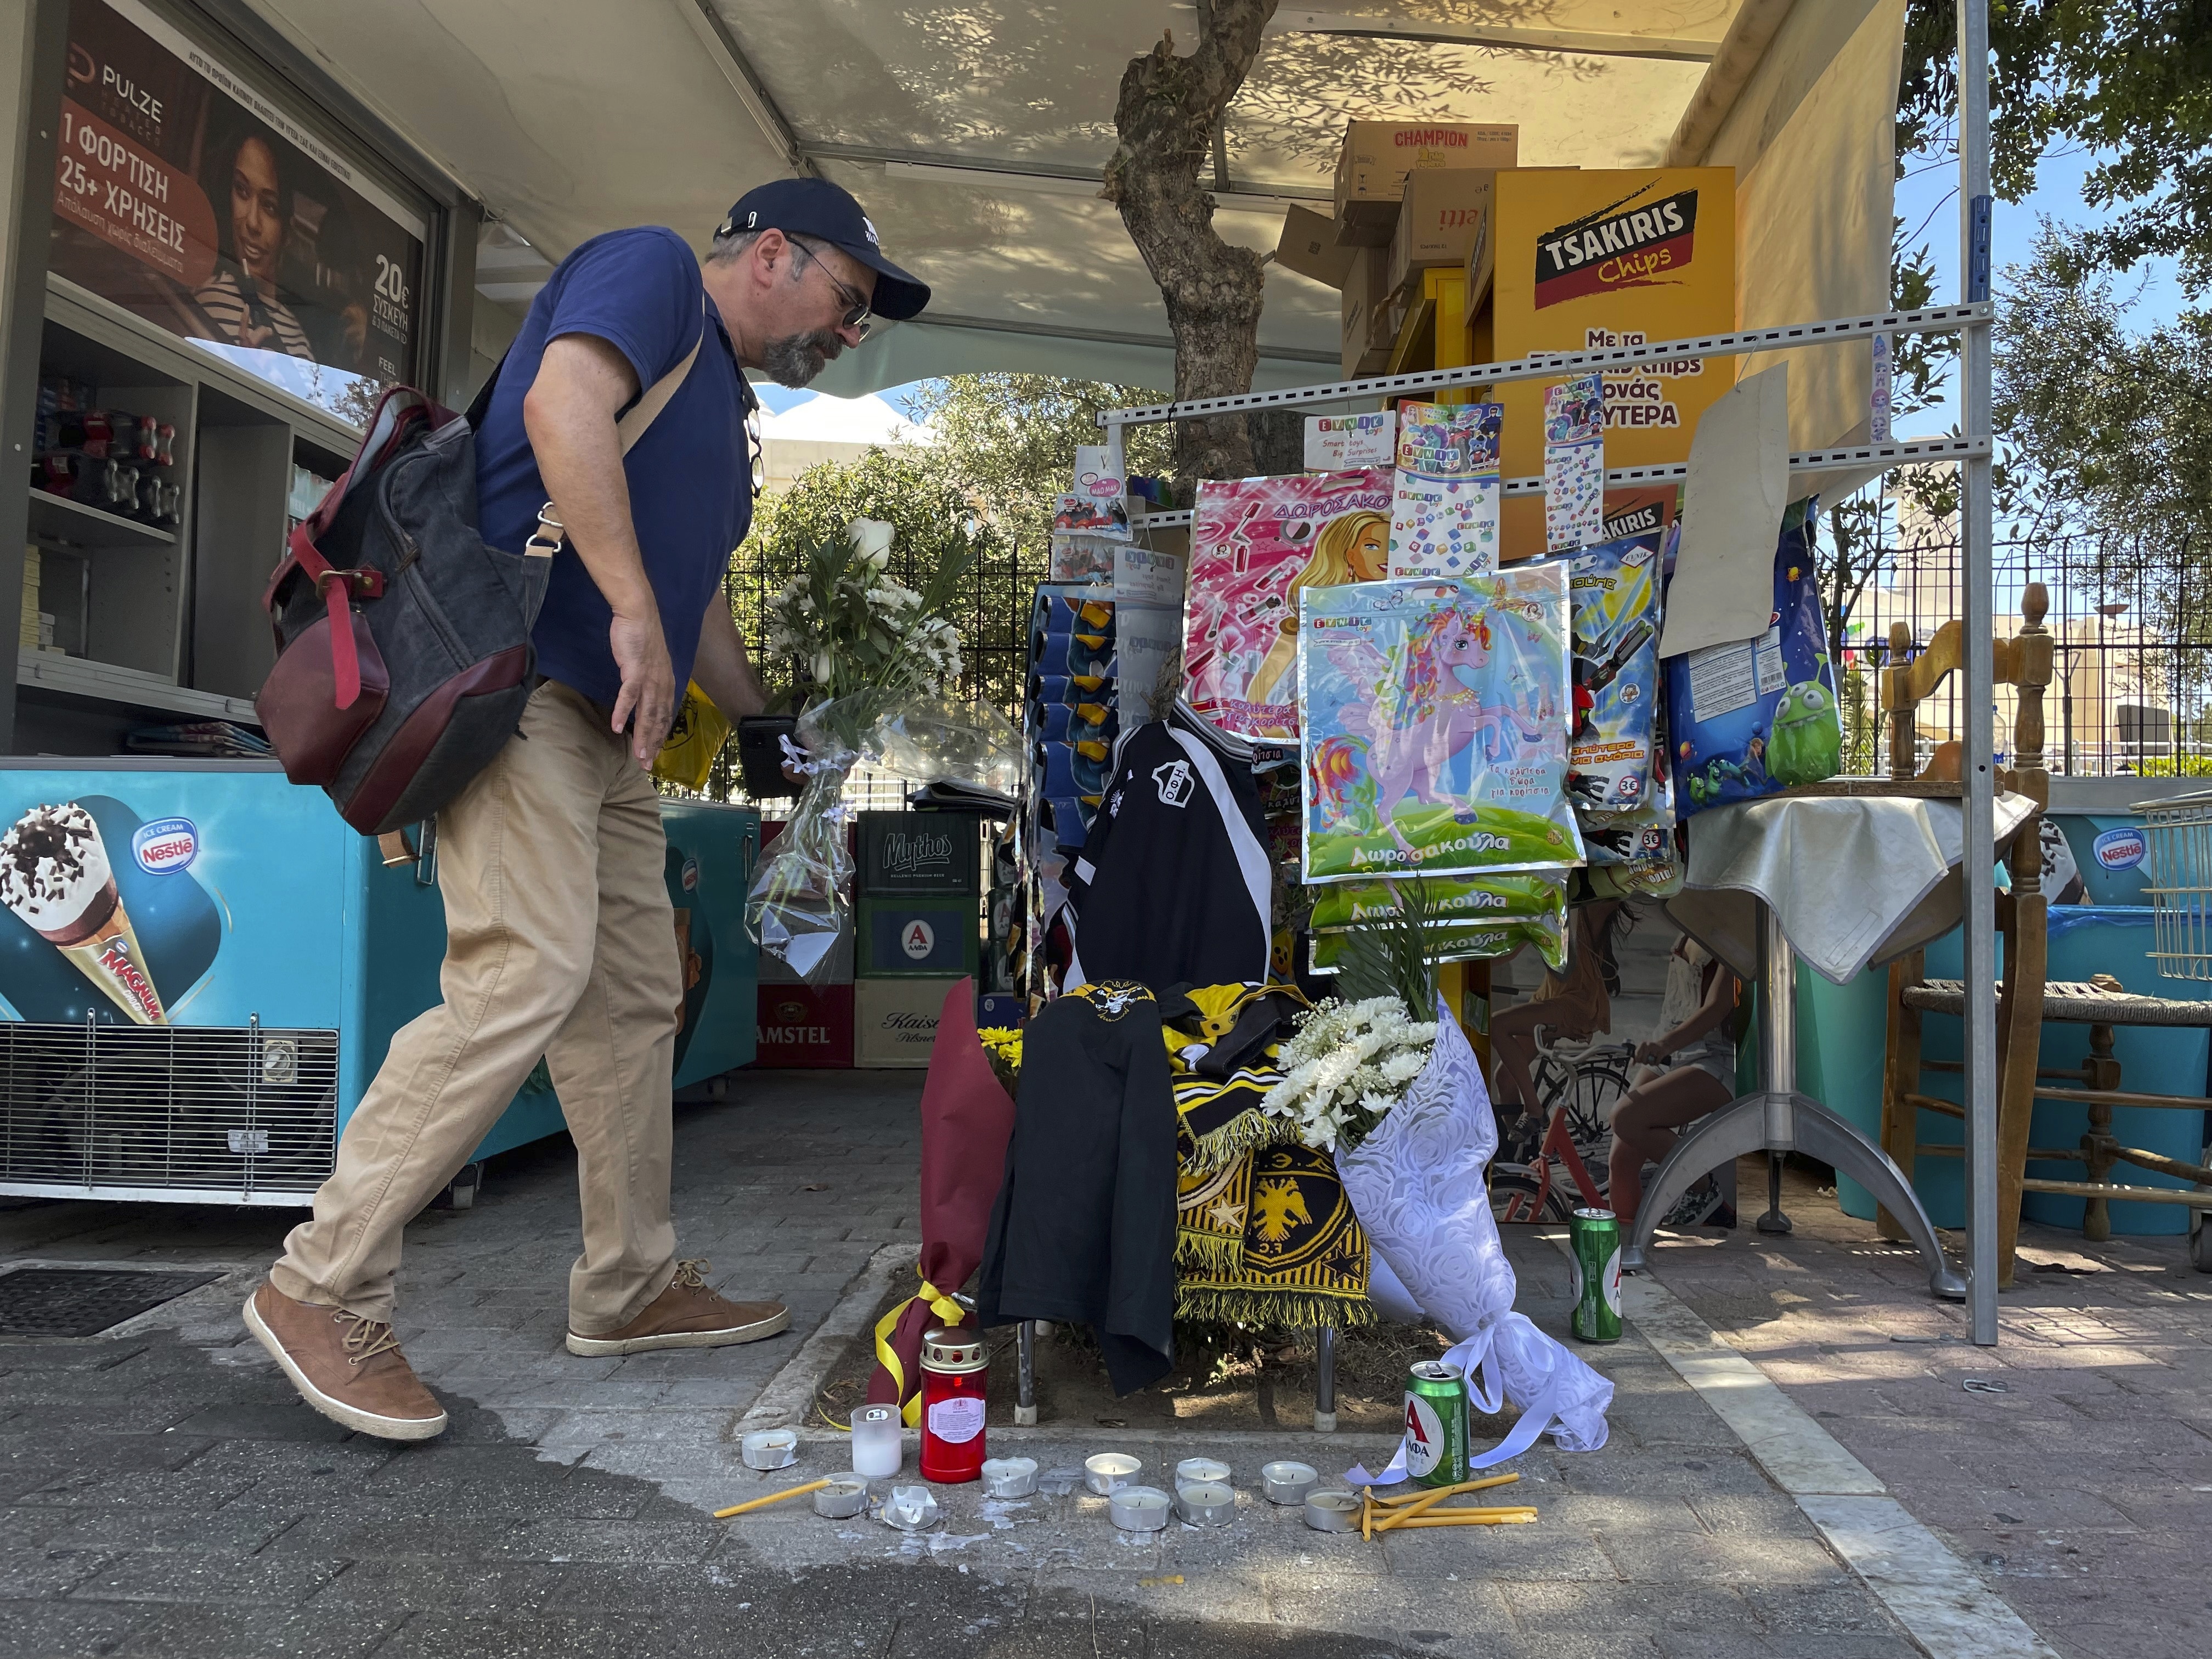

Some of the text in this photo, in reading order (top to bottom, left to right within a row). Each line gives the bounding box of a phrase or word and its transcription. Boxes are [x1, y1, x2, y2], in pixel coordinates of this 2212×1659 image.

[189, 51, 203, 67] ΑΥΤΟ
[204, 60, 211, 74] ΤΟ
[103, 64, 163, 123] PULZE
[1395, 129, 1468, 148] CHAMPION
[64, 113, 168, 204] 1 ΦΟΡΤΙΣΗ
[60, 155, 185, 253] 25+ ΧΡΗΣΕΙΣ
[57, 190, 105, 231] Απόλαυση
[108, 221, 132, 246] χωρίς
[1545, 201, 1684, 270] TSAKIRIS
[1598, 248, 1672, 283] Chips
[375, 255, 409, 308] 20€
[373, 294, 408, 331] ΣΥΣΚΕΥΗ
[377, 318, 380, 329] 3
[381, 321, 399, 341] ΠΑΚΕΤΑ
[1589, 331, 1643, 347] Με τα
[379, 357, 396, 376] FEEL
[1603, 379, 1659, 400] ρνάς
[1320, 416, 1382, 431] EVNIK
[1603, 405, 1677, 425] ΥΤΕΡΑ
[1365, 427, 1383, 436] toys
[1333, 447, 1377, 458] Big Surprises
[1403, 445, 1458, 460] EVNIK
[1105, 485, 1117, 493] MAX
[1400, 491, 1442, 501] EVNIK
[1274, 494, 1392, 518] ΔΩΡΟΣΑΚΟ
[1458, 521, 1494, 529] EVNIK
[1602, 508, 1656, 540] AKIRIS
[1396, 567, 1440, 575] EVNIK
[1463, 551, 1488, 575] NIK
[1314, 617, 1371, 628] EVNIK
[1207, 699, 1291, 716] Τα καλύτερα
[1251, 716, 1299, 729] κορίτσι
[1252, 748, 1282, 764] ρίτσια
[1572, 741, 1635, 755] αλύτερα
[1594, 750, 1645, 764] αγόρια
[1489, 764, 1546, 777] Τα καλύτερα
[1510, 777, 1535, 788] δώρα
[1622, 780, 1638, 791] 3€
[1491, 787, 1549, 799] για κορίτσια
[144, 824, 184, 838] ICE CREAM
[1644, 834, 1660, 845] 3€
[2112, 832, 2134, 840] CREAM
[883, 833, 952, 871] Mythos
[1350, 832, 1510, 868] Δωροσακούλα
[1646, 866, 1675, 883] όρια!
[909, 925, 928, 944] Α
[1440, 932, 1508, 951] κούλα
[97, 948, 161, 1021] MAGNUM
[123, 989, 143, 1012] CHOCO
[881, 1012, 939, 1030] Kaise
[755, 1025, 831, 1043] AMSTEL
[1406, 1400, 1431, 1443] Α
[1406, 1440, 1430, 1457] ΛΦΑ
